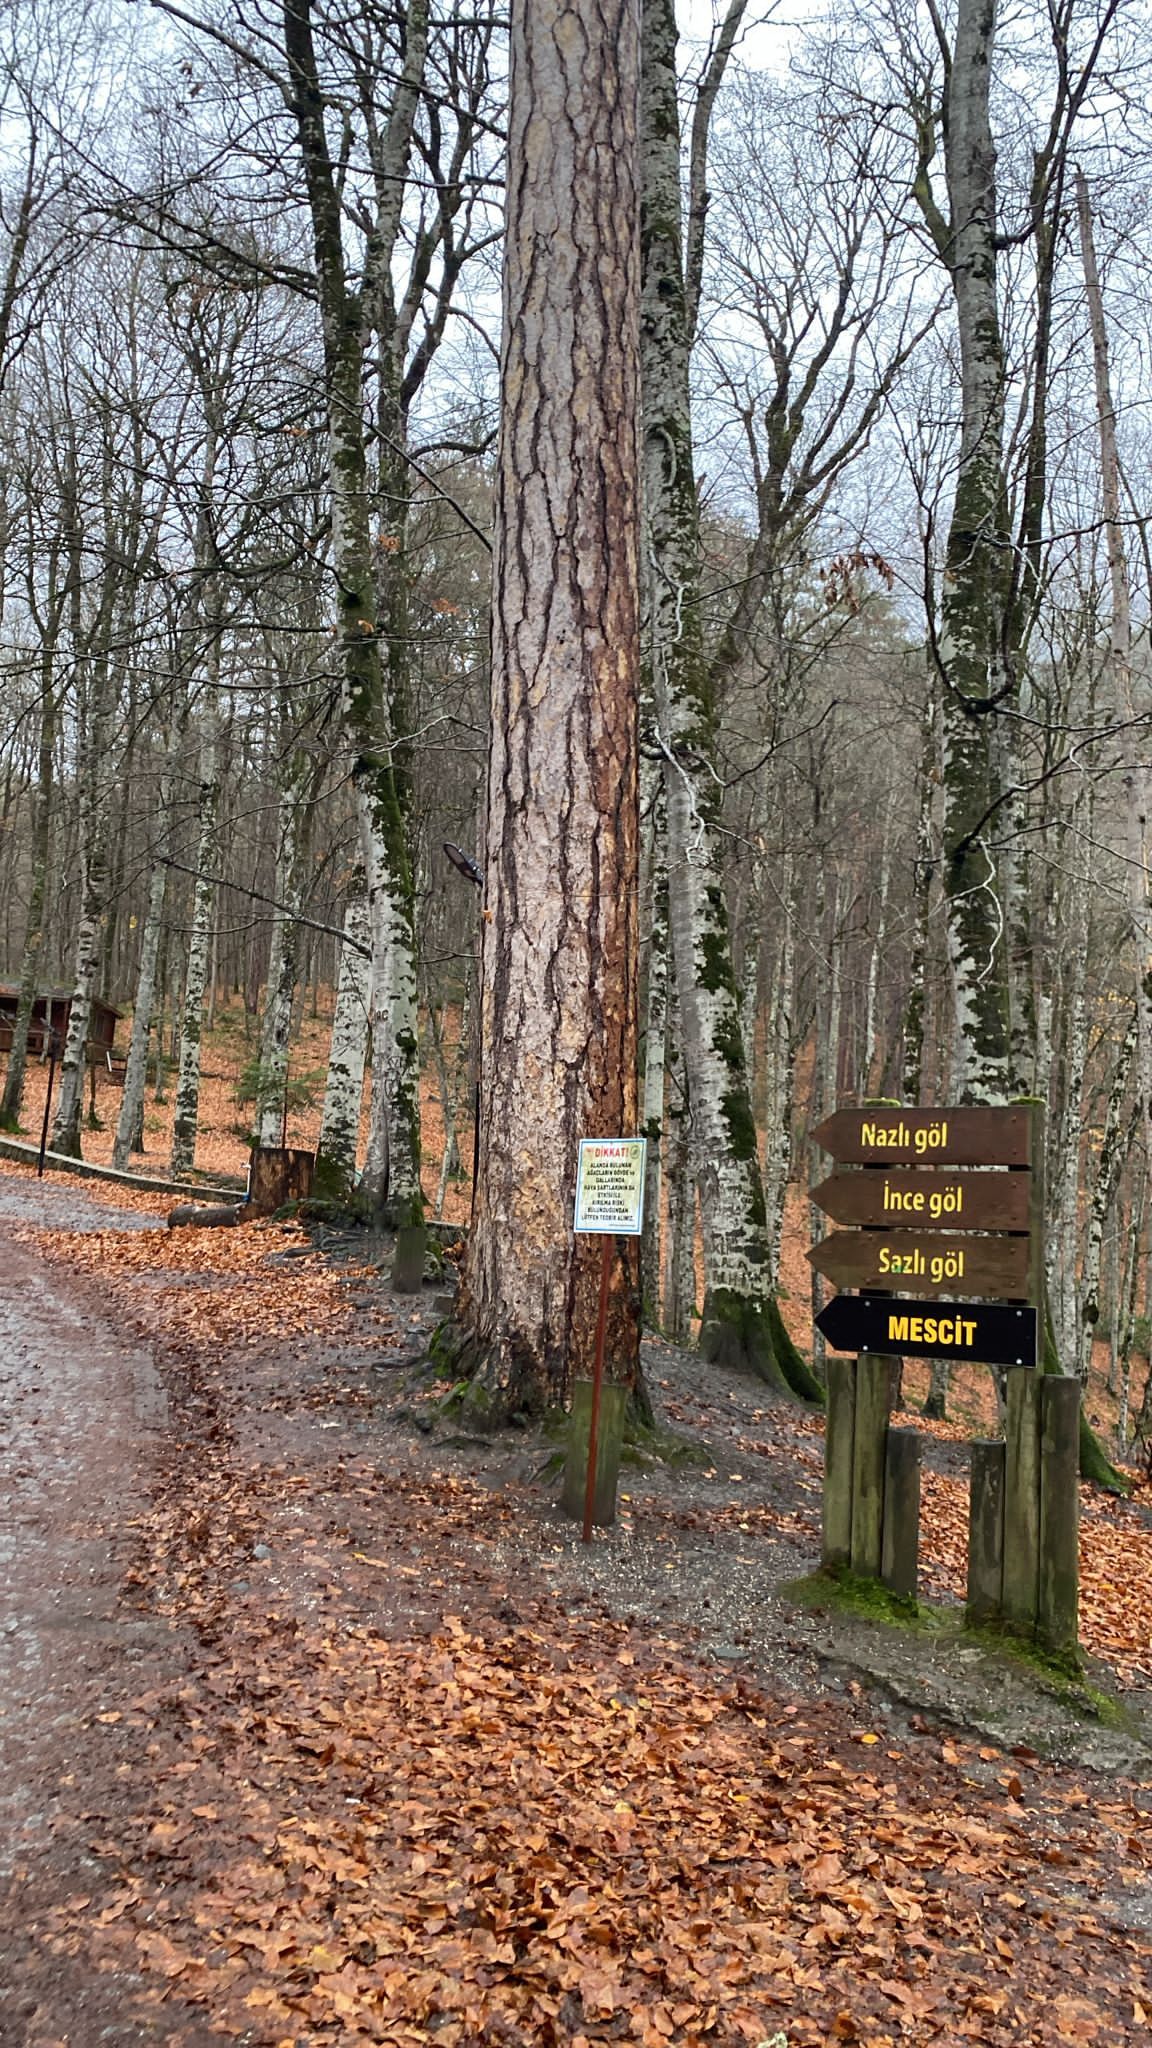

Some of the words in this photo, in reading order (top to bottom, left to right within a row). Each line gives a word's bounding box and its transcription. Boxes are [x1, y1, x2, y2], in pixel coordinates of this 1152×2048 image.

[861, 1122, 910, 1147] Nazlı
[915, 1122, 948, 1154] göl
[883, 1180, 925, 1211] İnce
[929, 1186, 962, 1218] göl
[878, 1248, 925, 1275] Sazlı
[931, 1251, 964, 1283] göl
[888, 1315, 977, 1346] MESCİT
